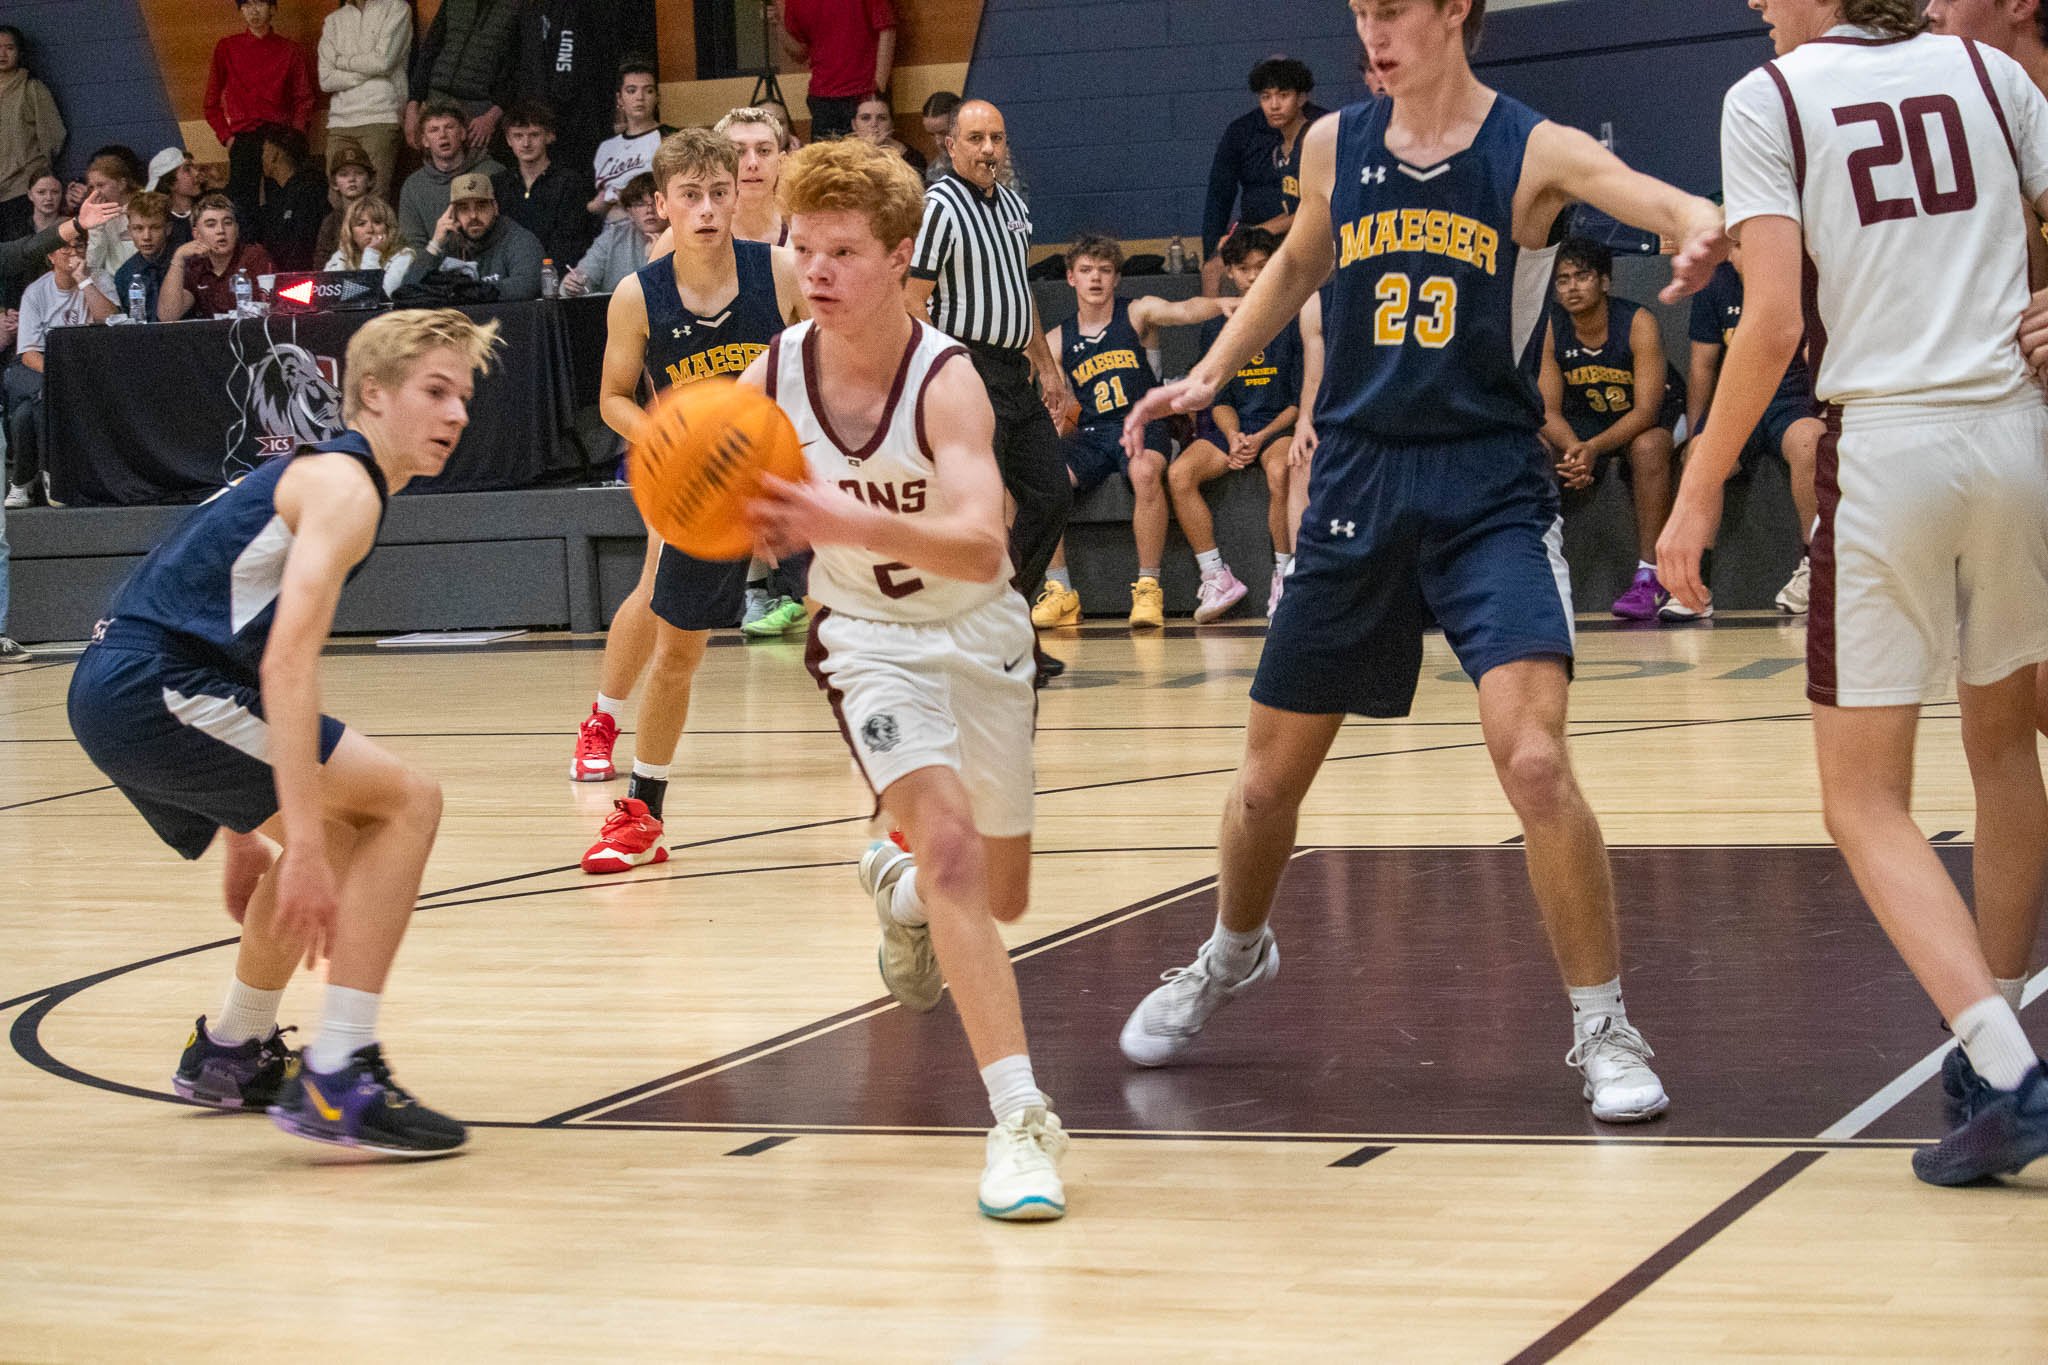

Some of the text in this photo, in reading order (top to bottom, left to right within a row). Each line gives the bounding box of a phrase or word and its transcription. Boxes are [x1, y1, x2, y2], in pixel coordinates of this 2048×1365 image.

[1831, 94, 1978, 227] 20
[1339, 208, 1499, 276] MAESER
[1374, 272, 1458, 348] 23
[665, 342, 770, 389] MAESE
[1072, 349, 1139, 387] MAESER
[1563, 364, 1634, 385] MAESER
[1094, 375, 1129, 414] 21
[1585, 385, 1632, 412] 32
[270, 438, 290, 452] ICS
[838, 478, 927, 515] ONS
